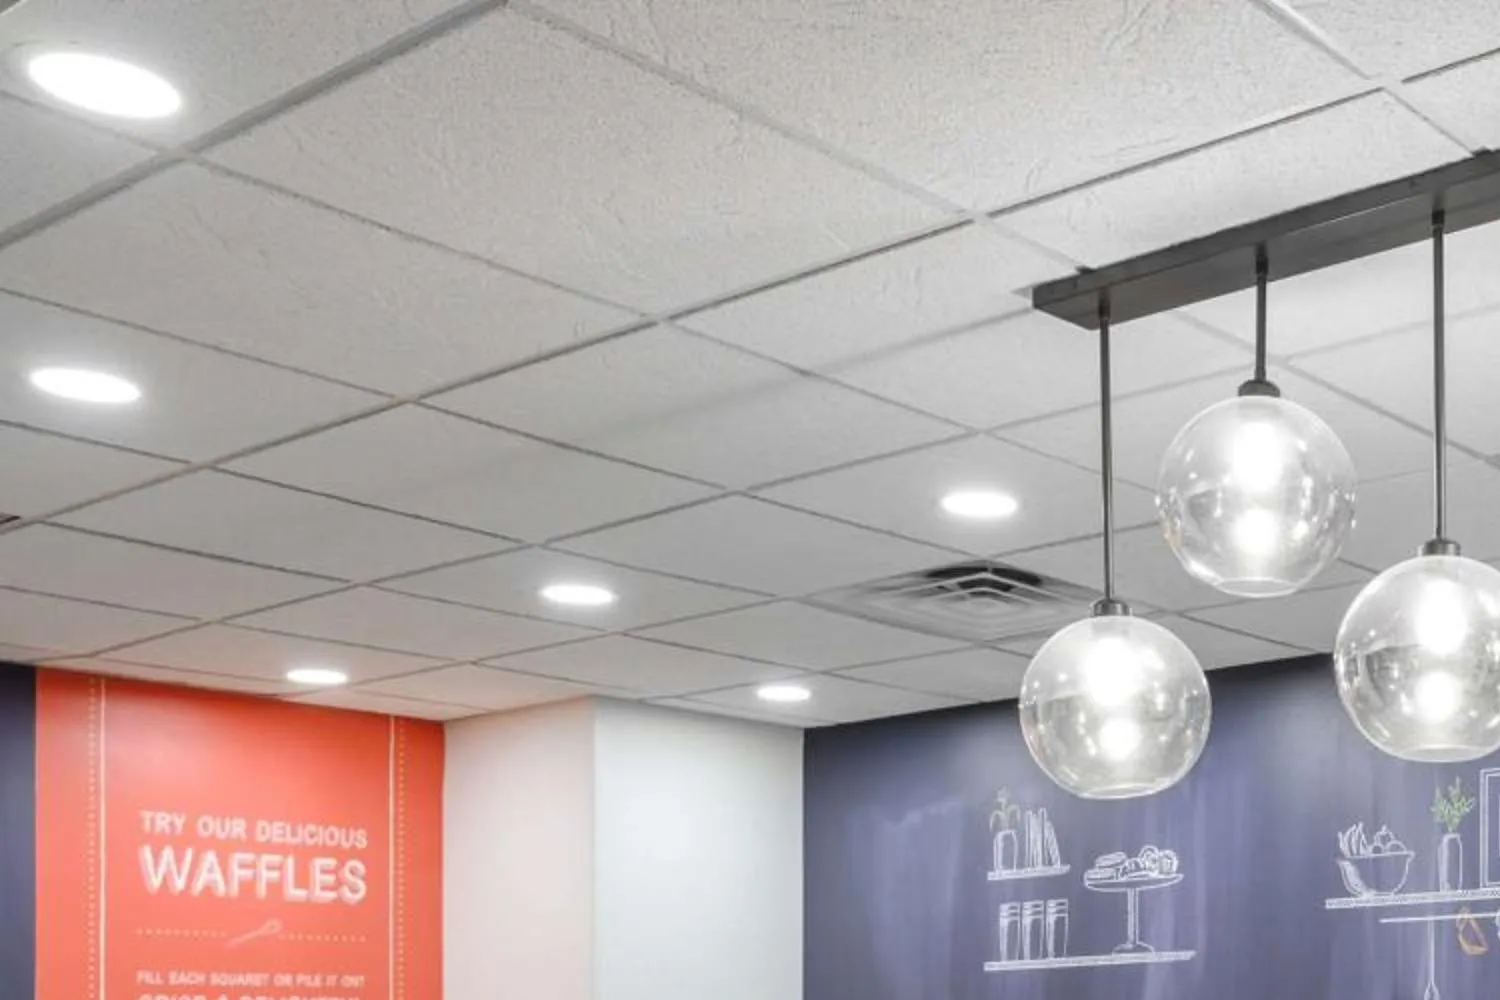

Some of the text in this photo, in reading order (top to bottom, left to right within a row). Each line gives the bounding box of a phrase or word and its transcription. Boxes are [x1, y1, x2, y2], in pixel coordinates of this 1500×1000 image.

[140, 810, 368, 849] TRY OUR DELICIOUS
[139, 845, 368, 904] WAFFLES
